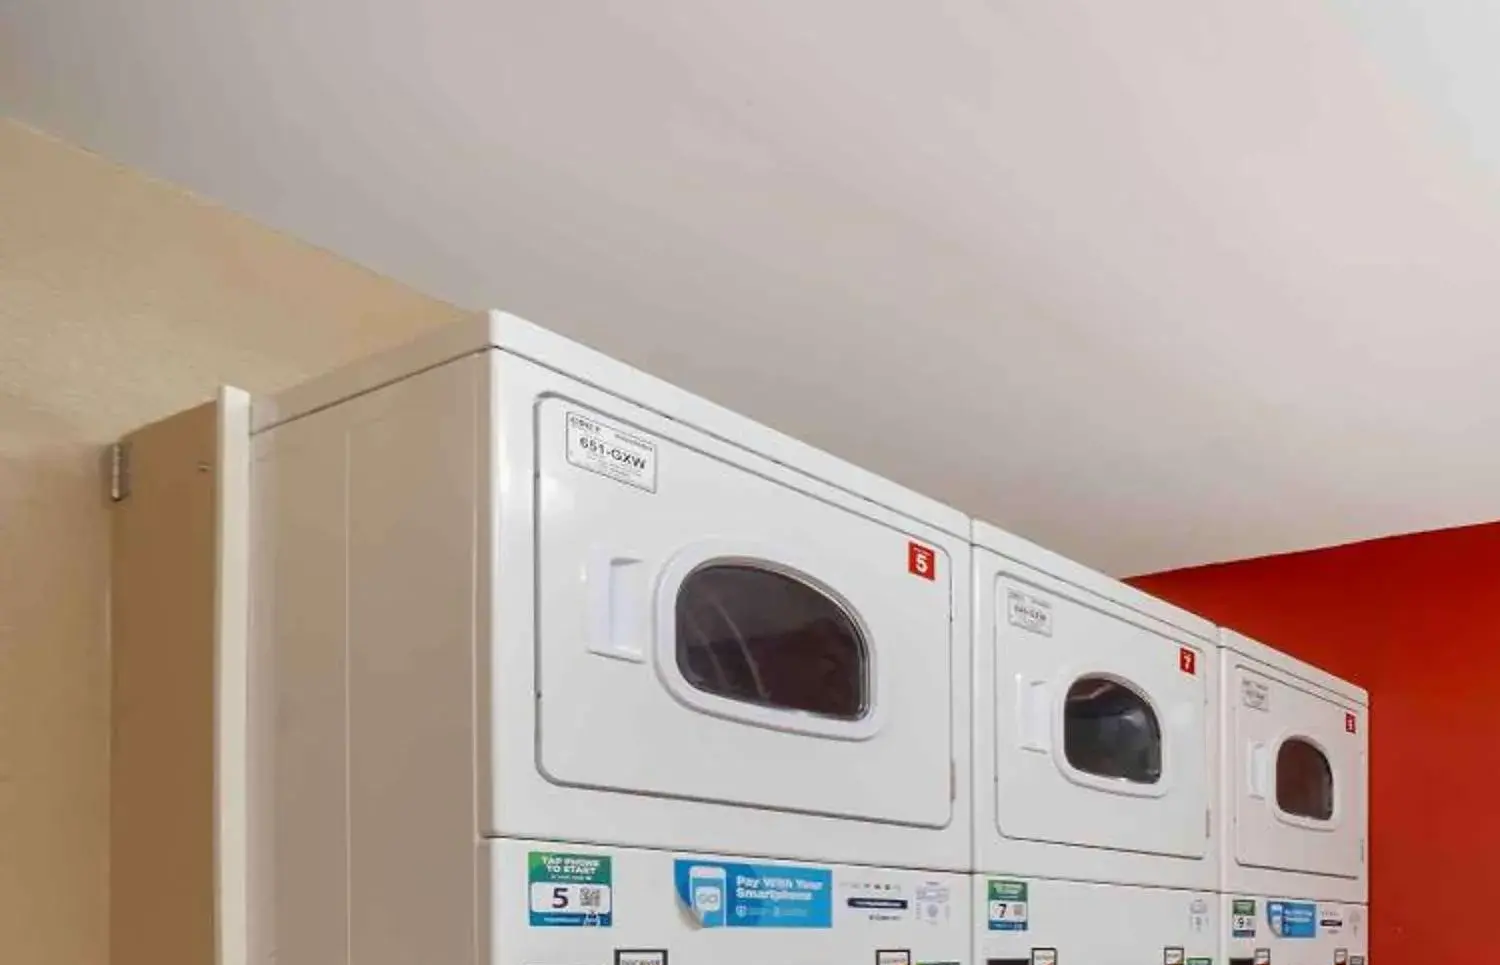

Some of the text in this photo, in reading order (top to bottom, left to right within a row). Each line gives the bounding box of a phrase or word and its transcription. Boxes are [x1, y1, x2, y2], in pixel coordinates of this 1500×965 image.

[914, 552, 929, 573] 5
[736, 875, 758, 888] Pay
[762, 877, 794, 890] With
[552, 887, 569, 908] 5
